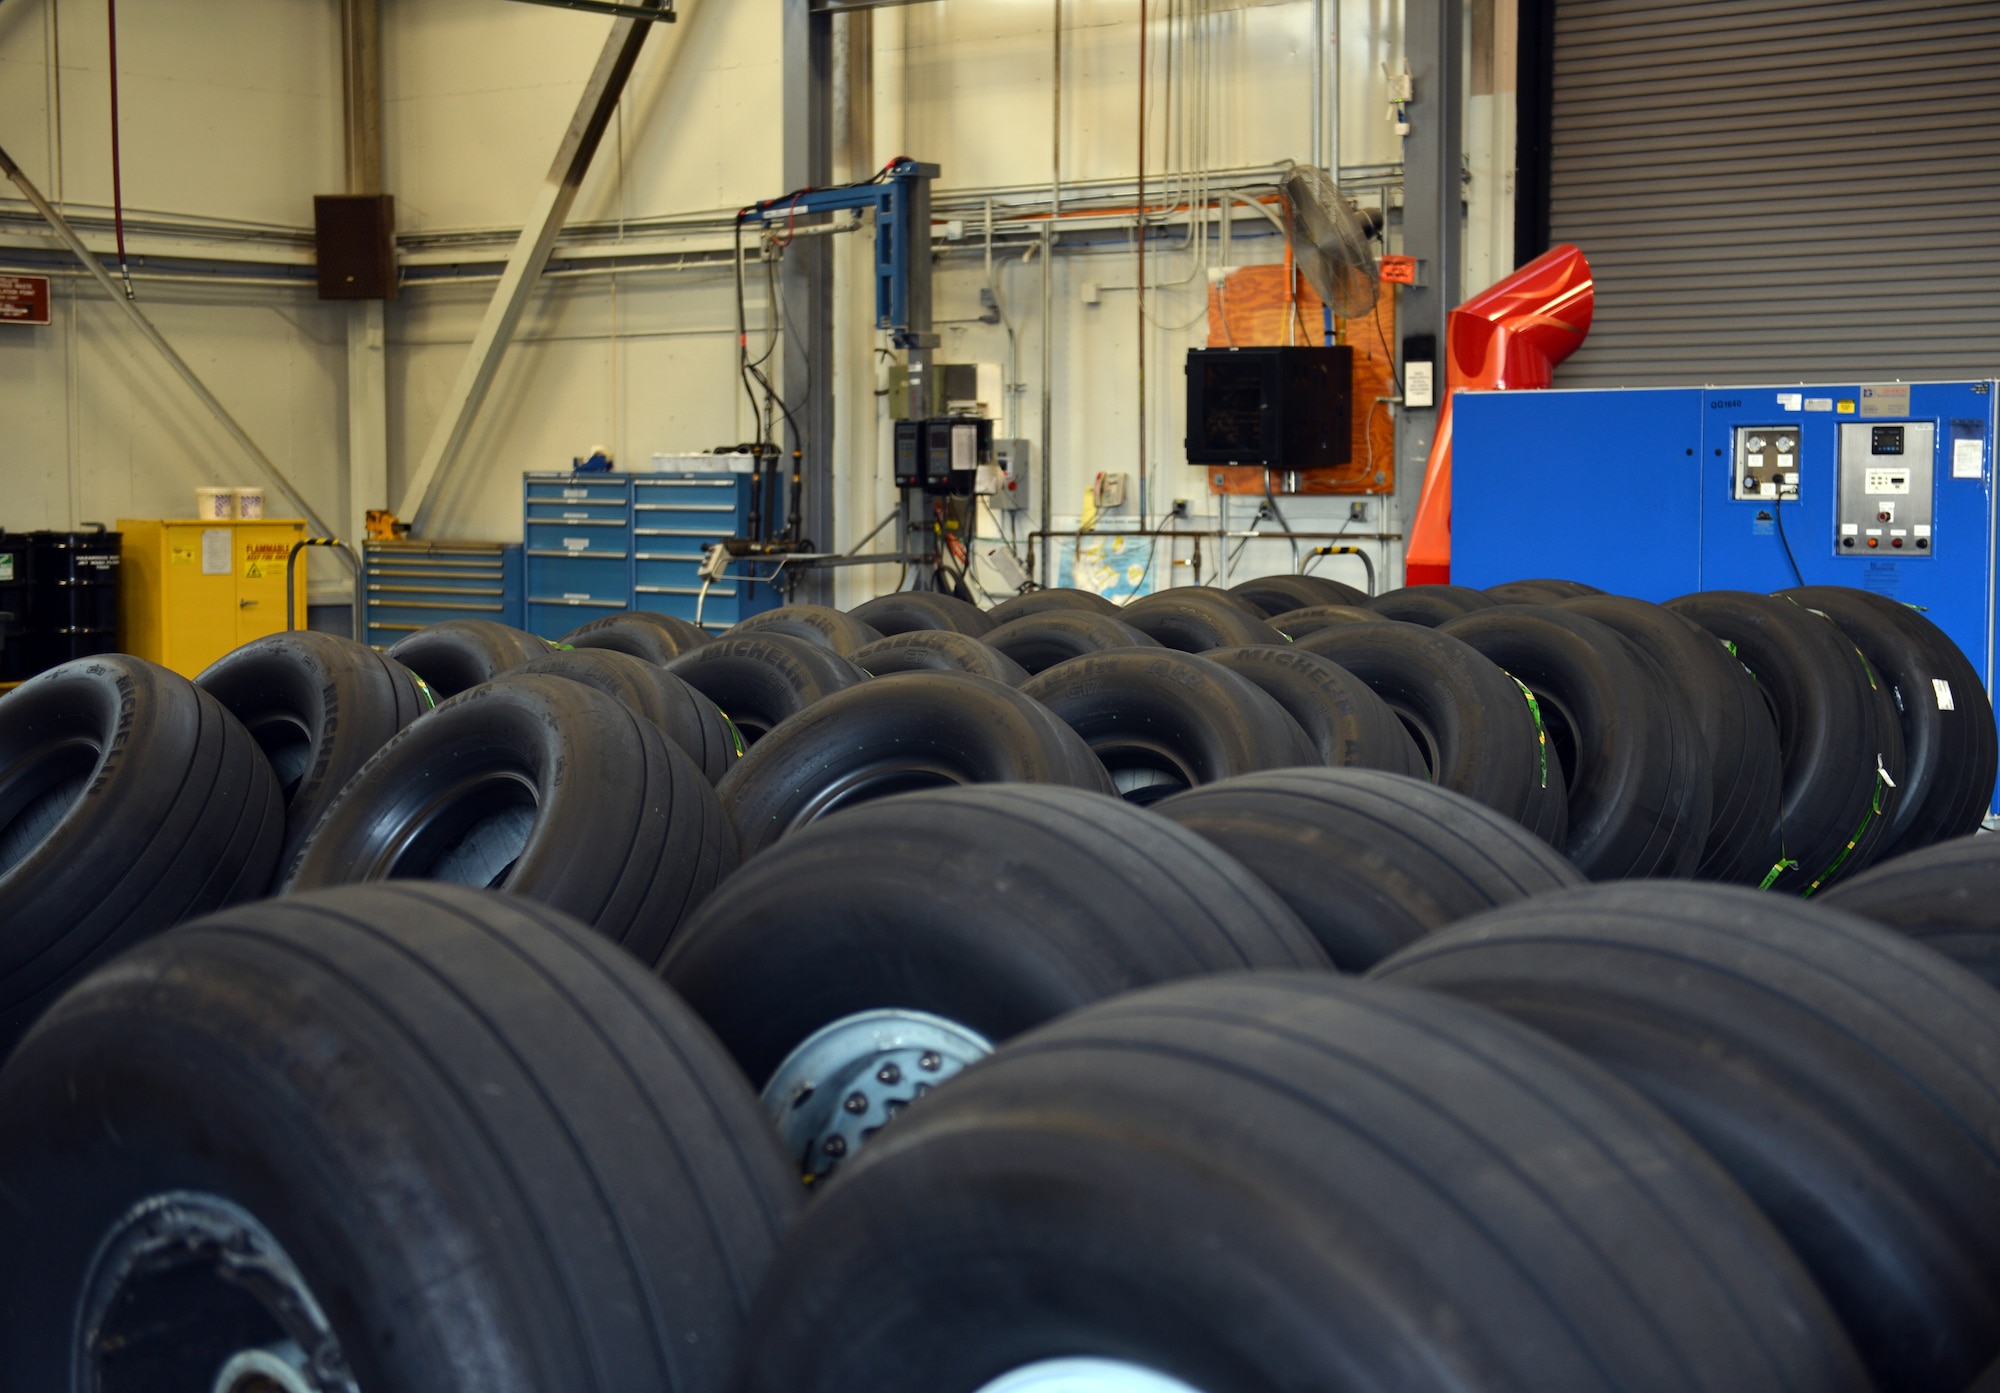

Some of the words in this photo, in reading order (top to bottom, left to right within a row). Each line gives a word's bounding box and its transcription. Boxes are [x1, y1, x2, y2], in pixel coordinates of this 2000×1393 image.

[246, 544, 290, 554] FLAMMABLE
[803, 612, 837, 638] AIR
[700, 640, 810, 693] MICHELIN
[1145, 658, 1206, 692] AIR
[1235, 649, 1355, 715] MICHELIN
[87, 674, 137, 795] MICHELIN
[303, 683, 339, 798] MICHEL
